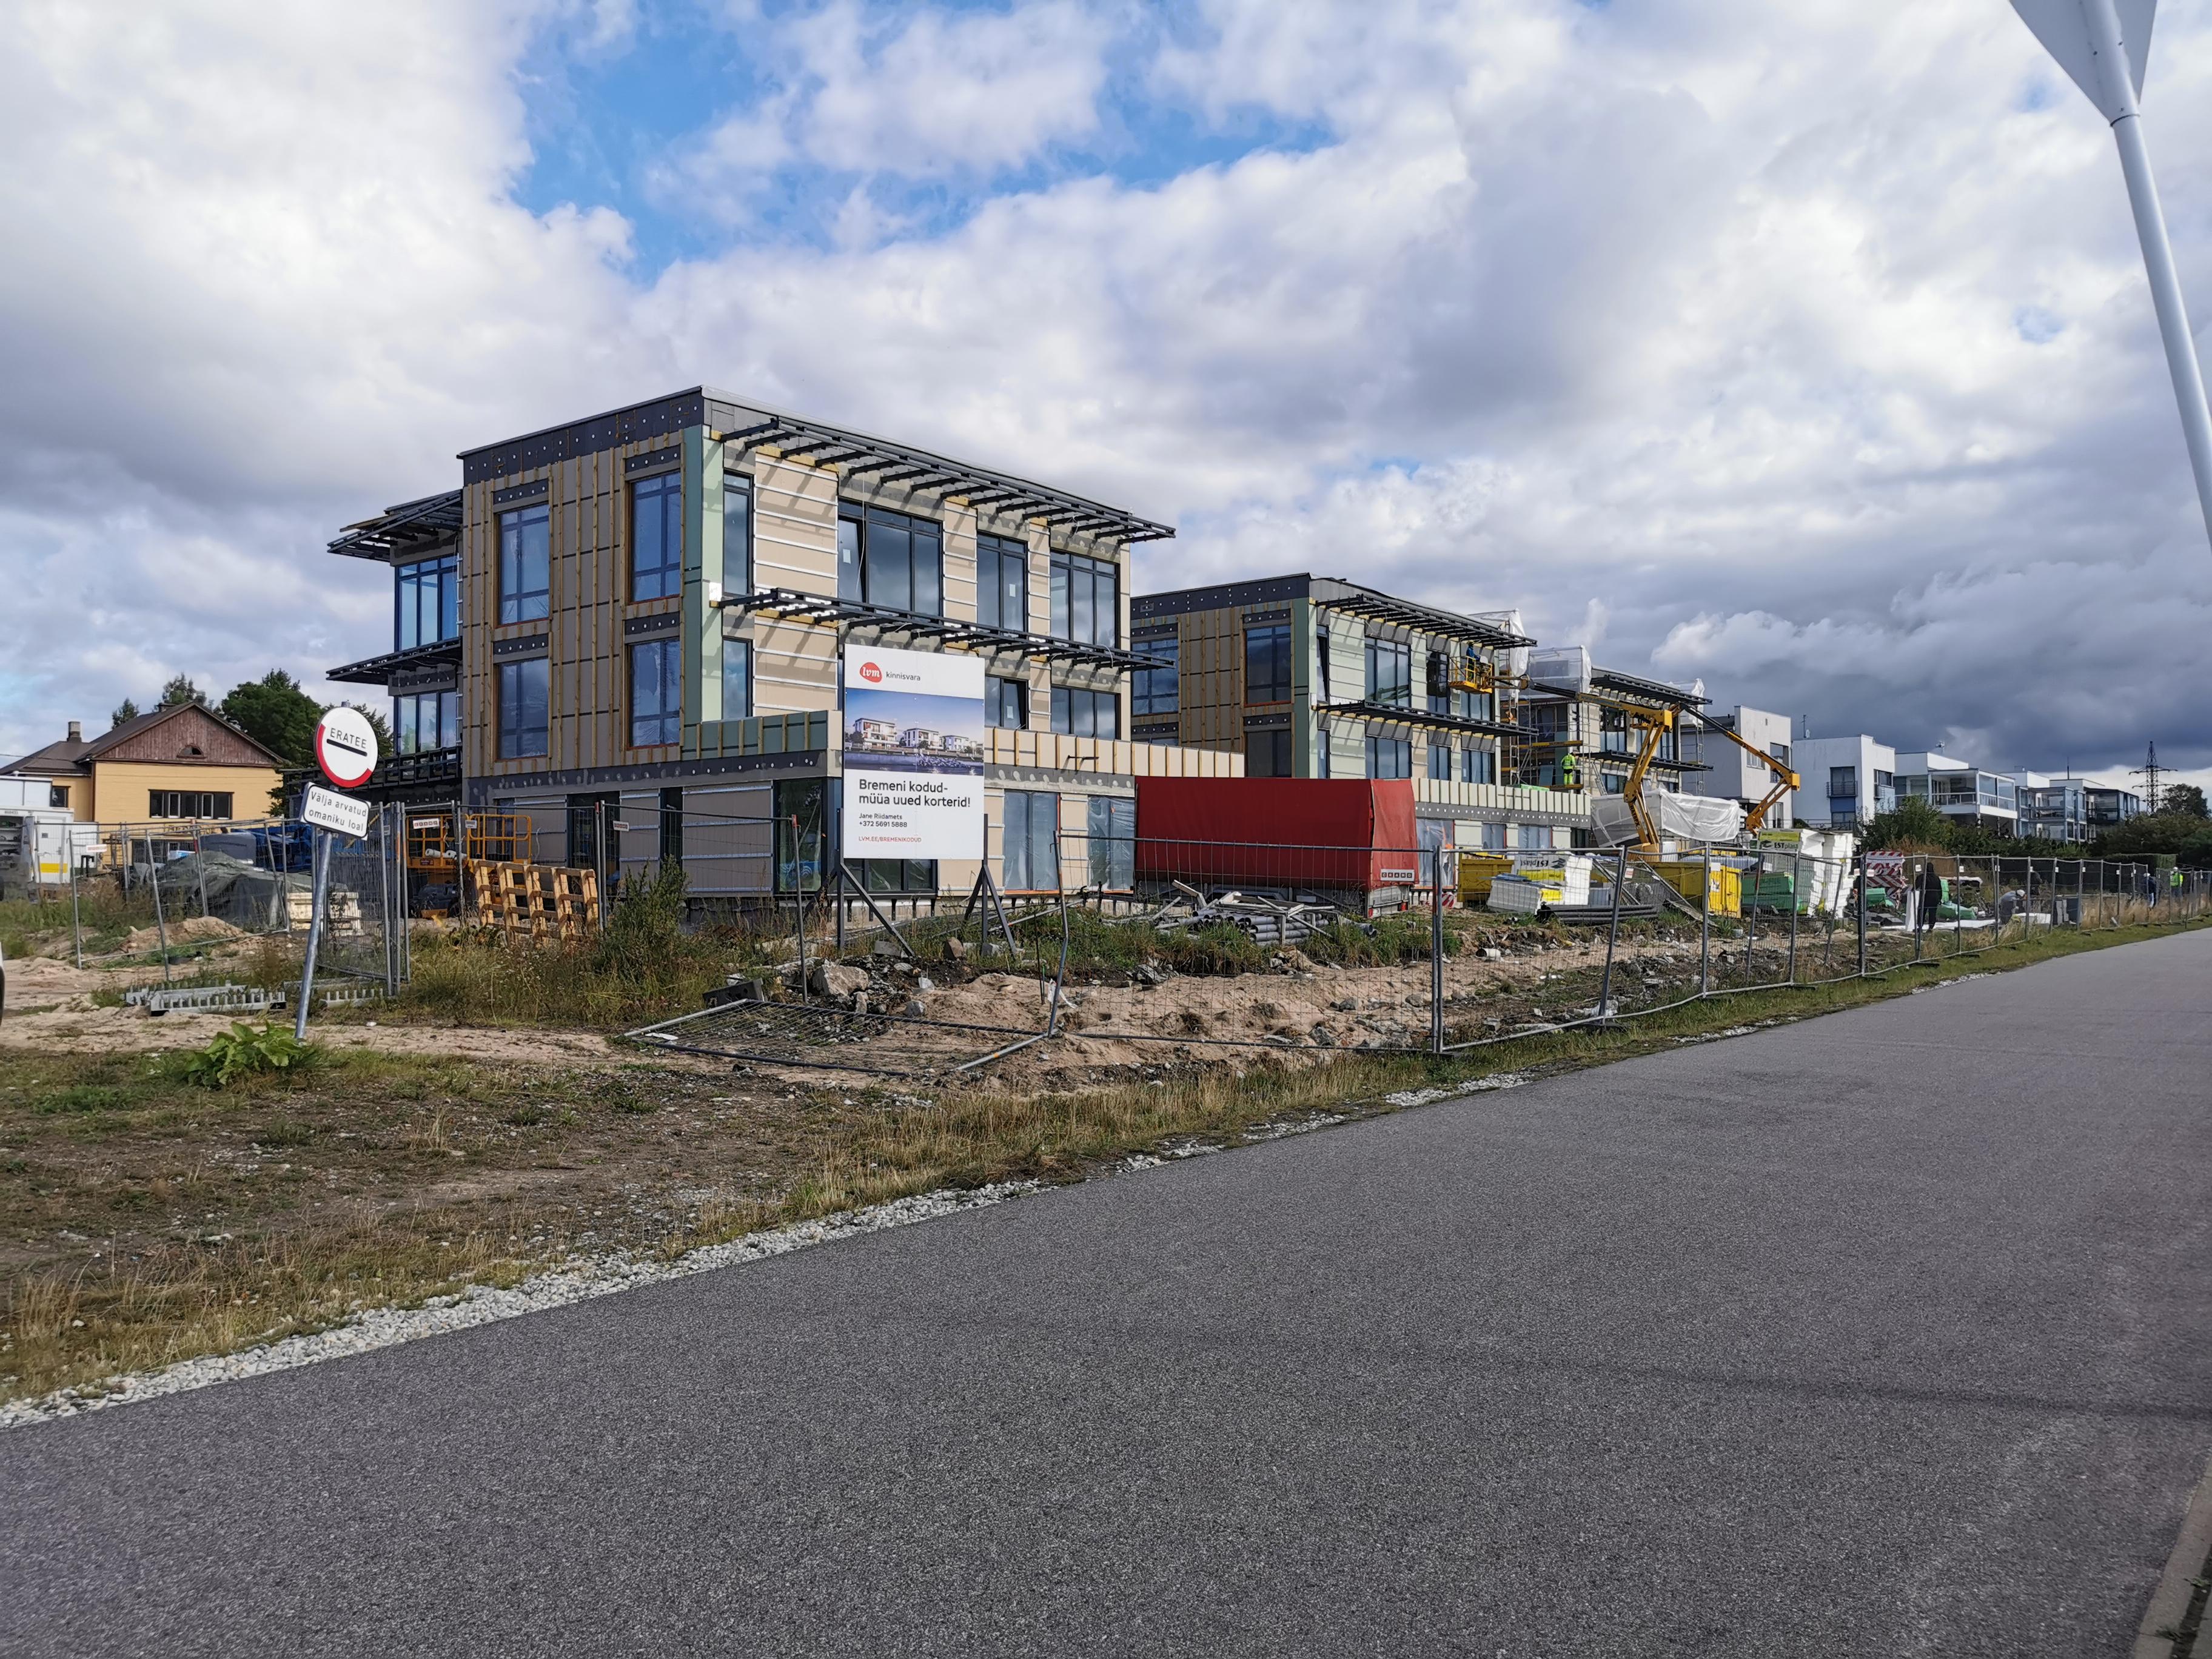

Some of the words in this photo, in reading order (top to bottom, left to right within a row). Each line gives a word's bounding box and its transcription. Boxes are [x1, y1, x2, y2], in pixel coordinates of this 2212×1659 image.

[862, 666, 880, 677] lvm
[886, 671, 920, 681] kinnisvara
[330, 728, 367, 749] ERATEE
[859, 779, 906, 791] Bremeni
[909, 781, 948, 793] kodud-
[311, 791, 332, 806] Välja
[335, 800, 367, 817] arvatud
[859, 793, 890, 805] müüa
[893, 795, 921, 805] uued
[924, 795, 970, 807] korterid!
[309, 809, 344, 826] omaniku
[349, 819, 363, 832] loal
